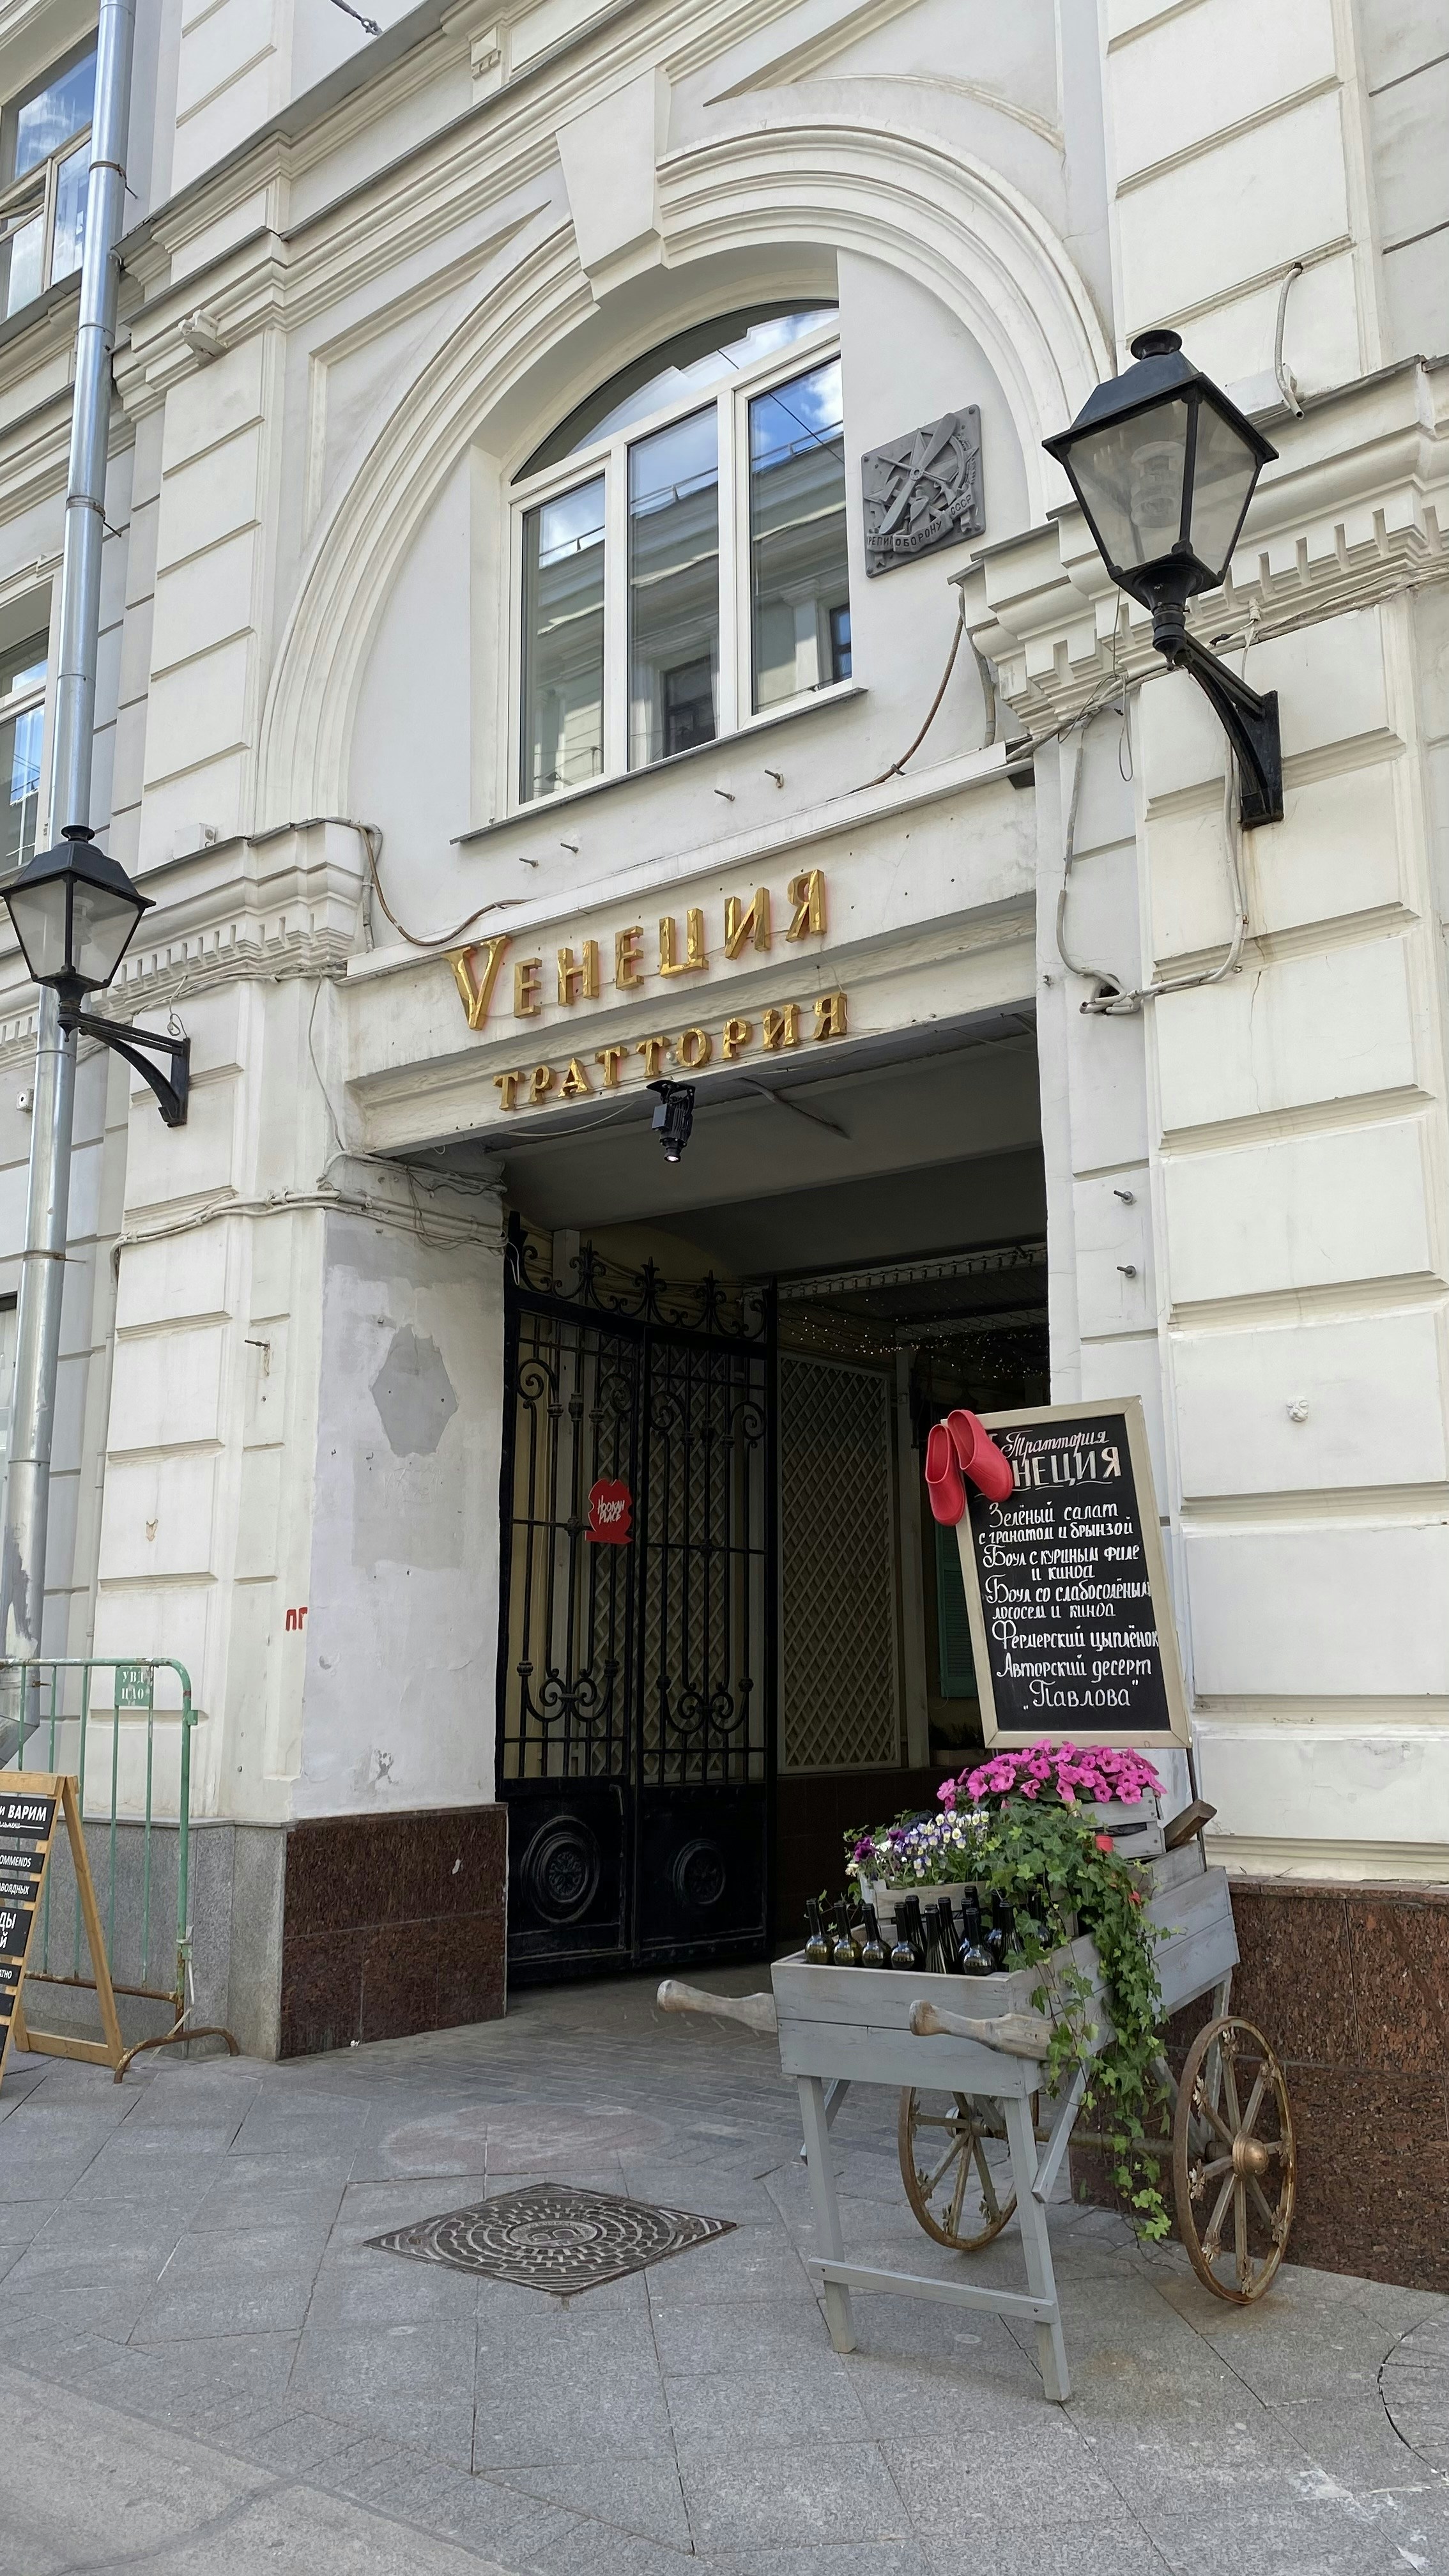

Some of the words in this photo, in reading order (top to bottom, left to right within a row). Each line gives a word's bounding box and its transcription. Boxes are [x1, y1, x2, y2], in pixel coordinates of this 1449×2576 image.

[867, 535, 893, 546] РЕПИ
[895, 520, 942, 547] ОБОРОНУ
[950, 494, 972, 516] СССР
[493, 992, 848, 1112] ТРАТТОРИЯ
[1000, 1429, 1110, 1468] Траттория
[1011, 1446, 1122, 1487] НЕЦИЯ
[978, 1533, 986, 1545] с
[988, 1528, 1055, 1545] гранатом
[1058, 1526, 1068, 1538] и
[1070, 1515, 1135, 1540] брынзой
[988, 1501, 1056, 1529] Зелёный
[1063, 1501, 1119, 1520] салат
[982, 1544, 1027, 1568] Боул
[1029, 1551, 1039, 1564] с
[1103, 1544, 1140, 1562] филе
[1031, 1567, 1043, 1581] и
[1048, 1564, 1096, 1581] киноа
[985, 1574, 1032, 1604] Боул
[1035, 1588, 1052, 1603] со
[992, 1604, 1048, 1620] лососем
[1050, 1604, 1062, 1619] и
[1068, 1602, 1118, 1619] киноа
[992, 1620, 1087, 1650] Фермерский
[1090, 1624, 1160, 1652] цыплёнок
[996, 1652, 1088, 1679] Авторский
[1090, 1658, 1152, 1683] десерт
[8, 1804, 47, 1822] ВАРИМ
[0, 1855, 32, 1867] OMMENDS
[0, 1882, 30, 1896] ВОЯДНЫХ
